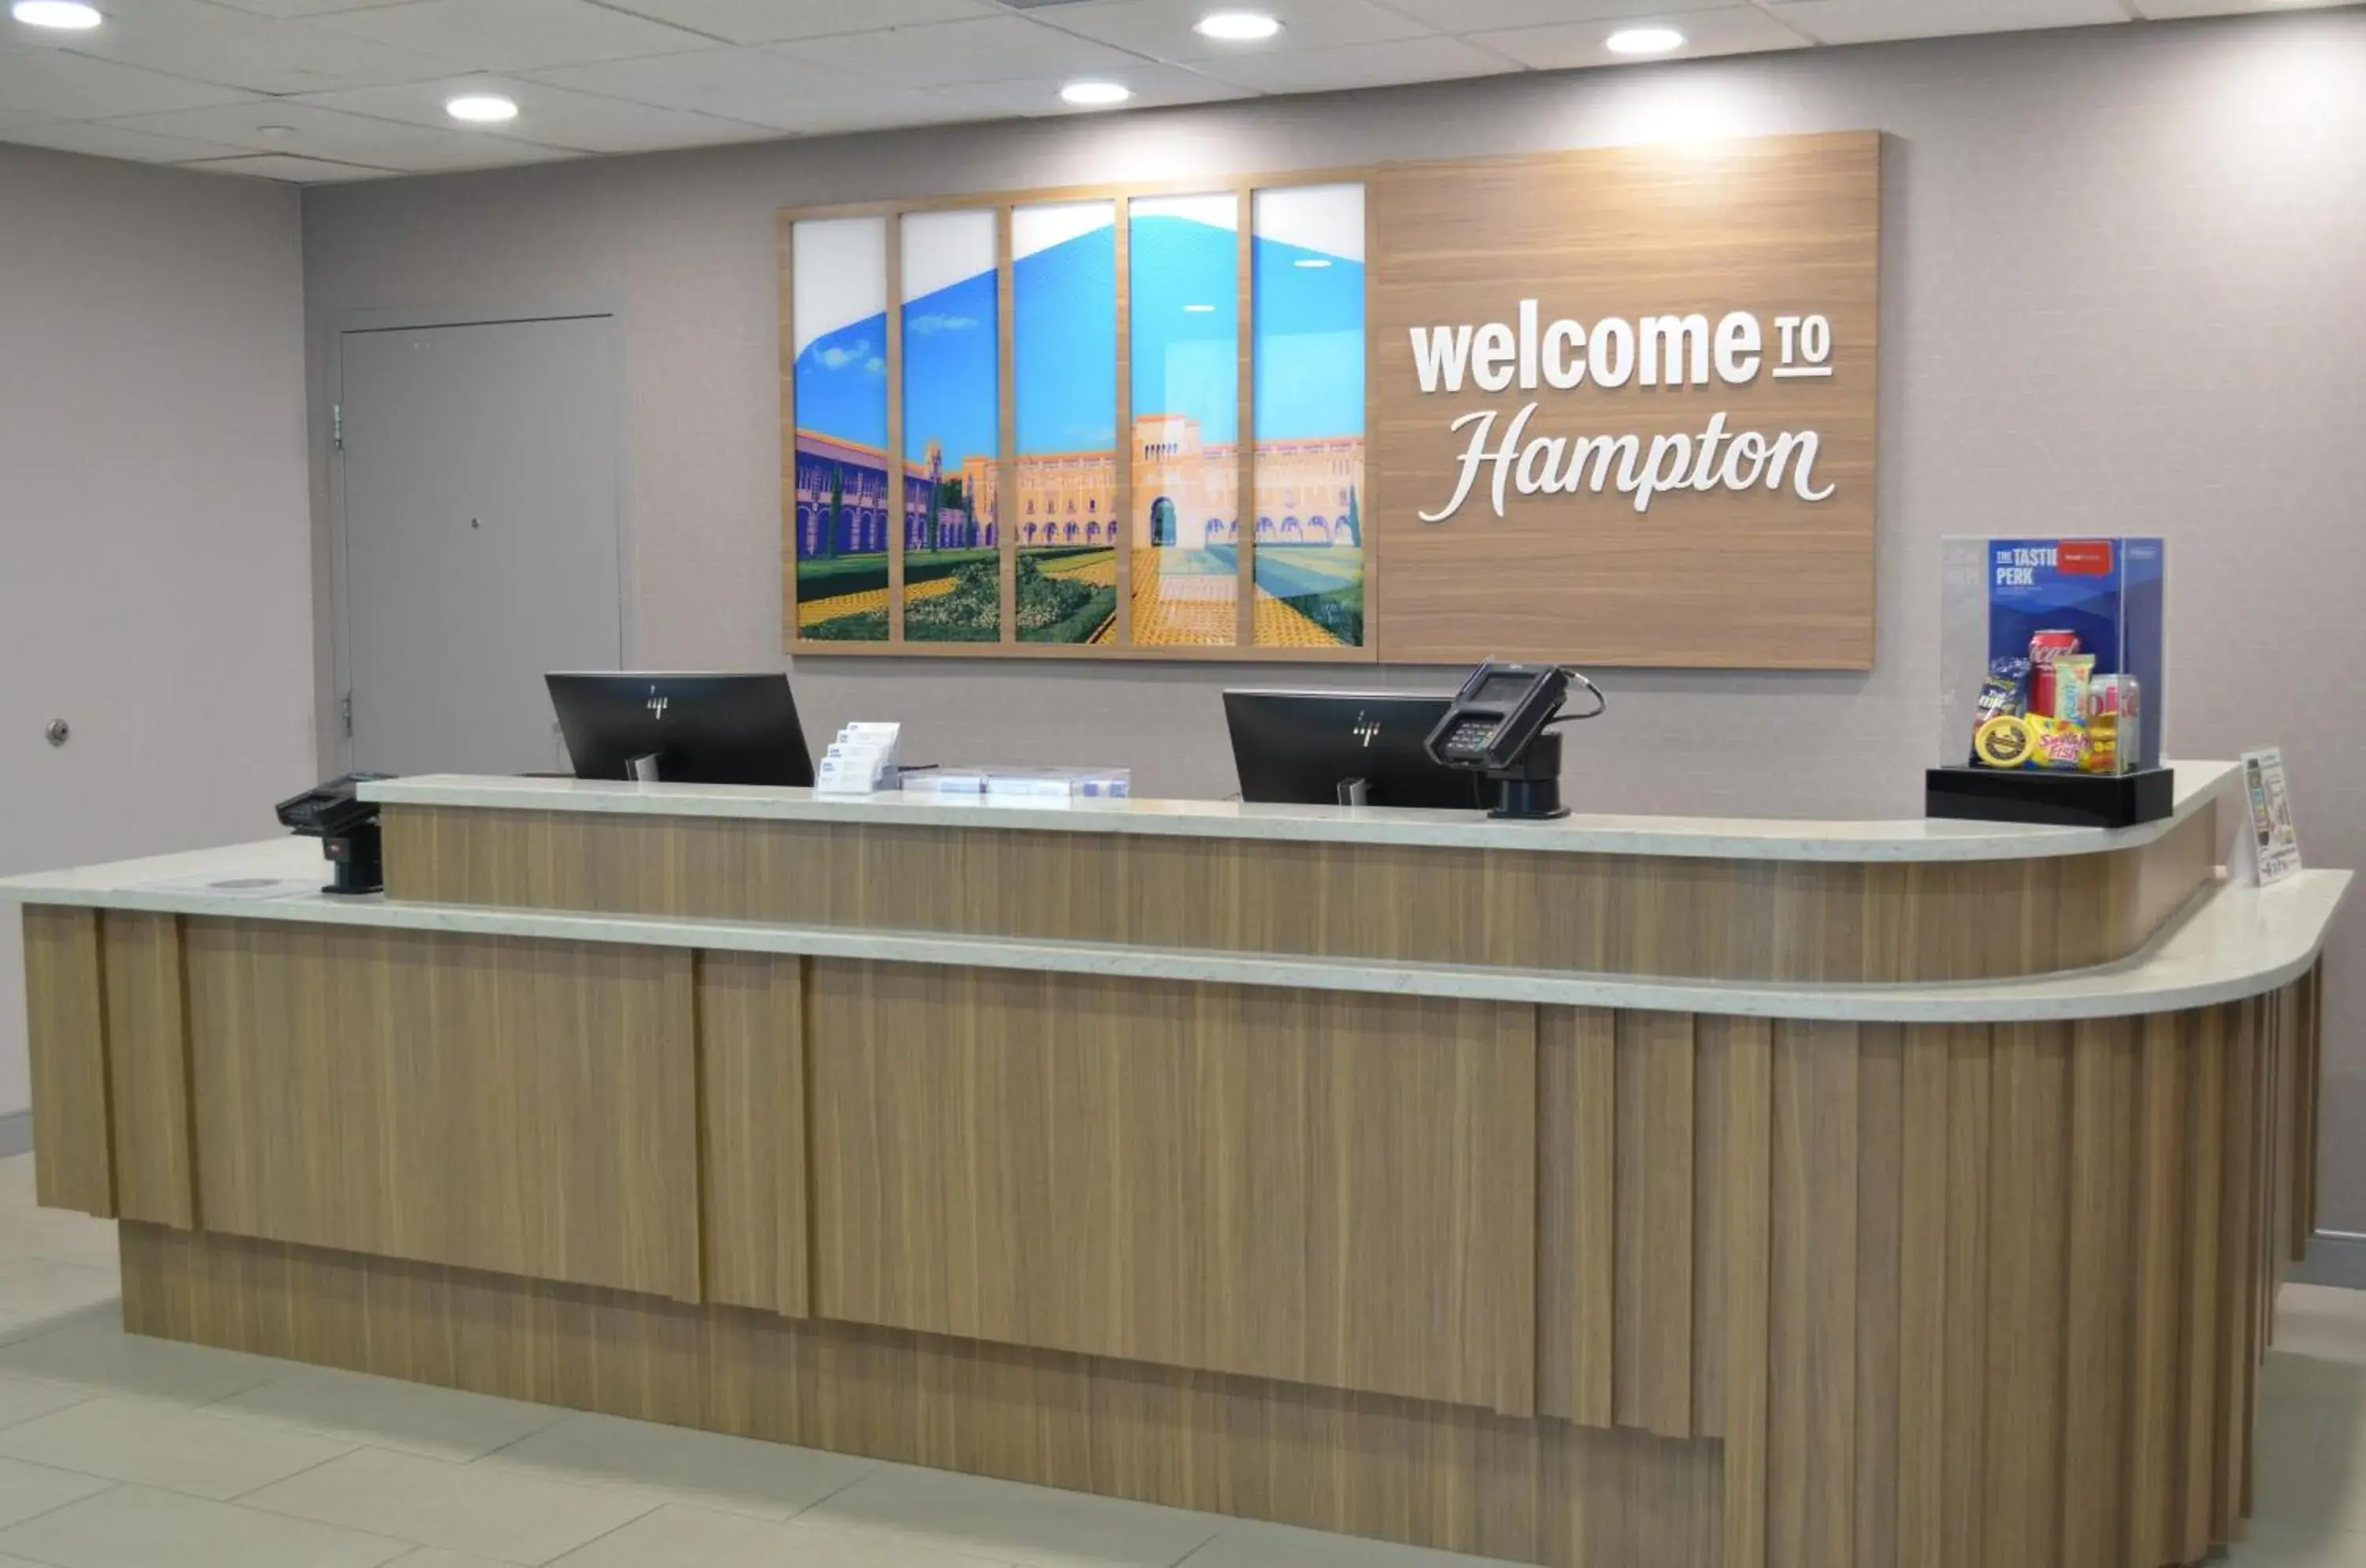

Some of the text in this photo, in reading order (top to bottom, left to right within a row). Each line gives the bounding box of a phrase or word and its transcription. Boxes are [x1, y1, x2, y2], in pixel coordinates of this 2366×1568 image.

[1409, 298, 1832, 393] welcome TO
[1418, 401, 1835, 522] Hampton
[1996, 567, 2033, 585] PERK
